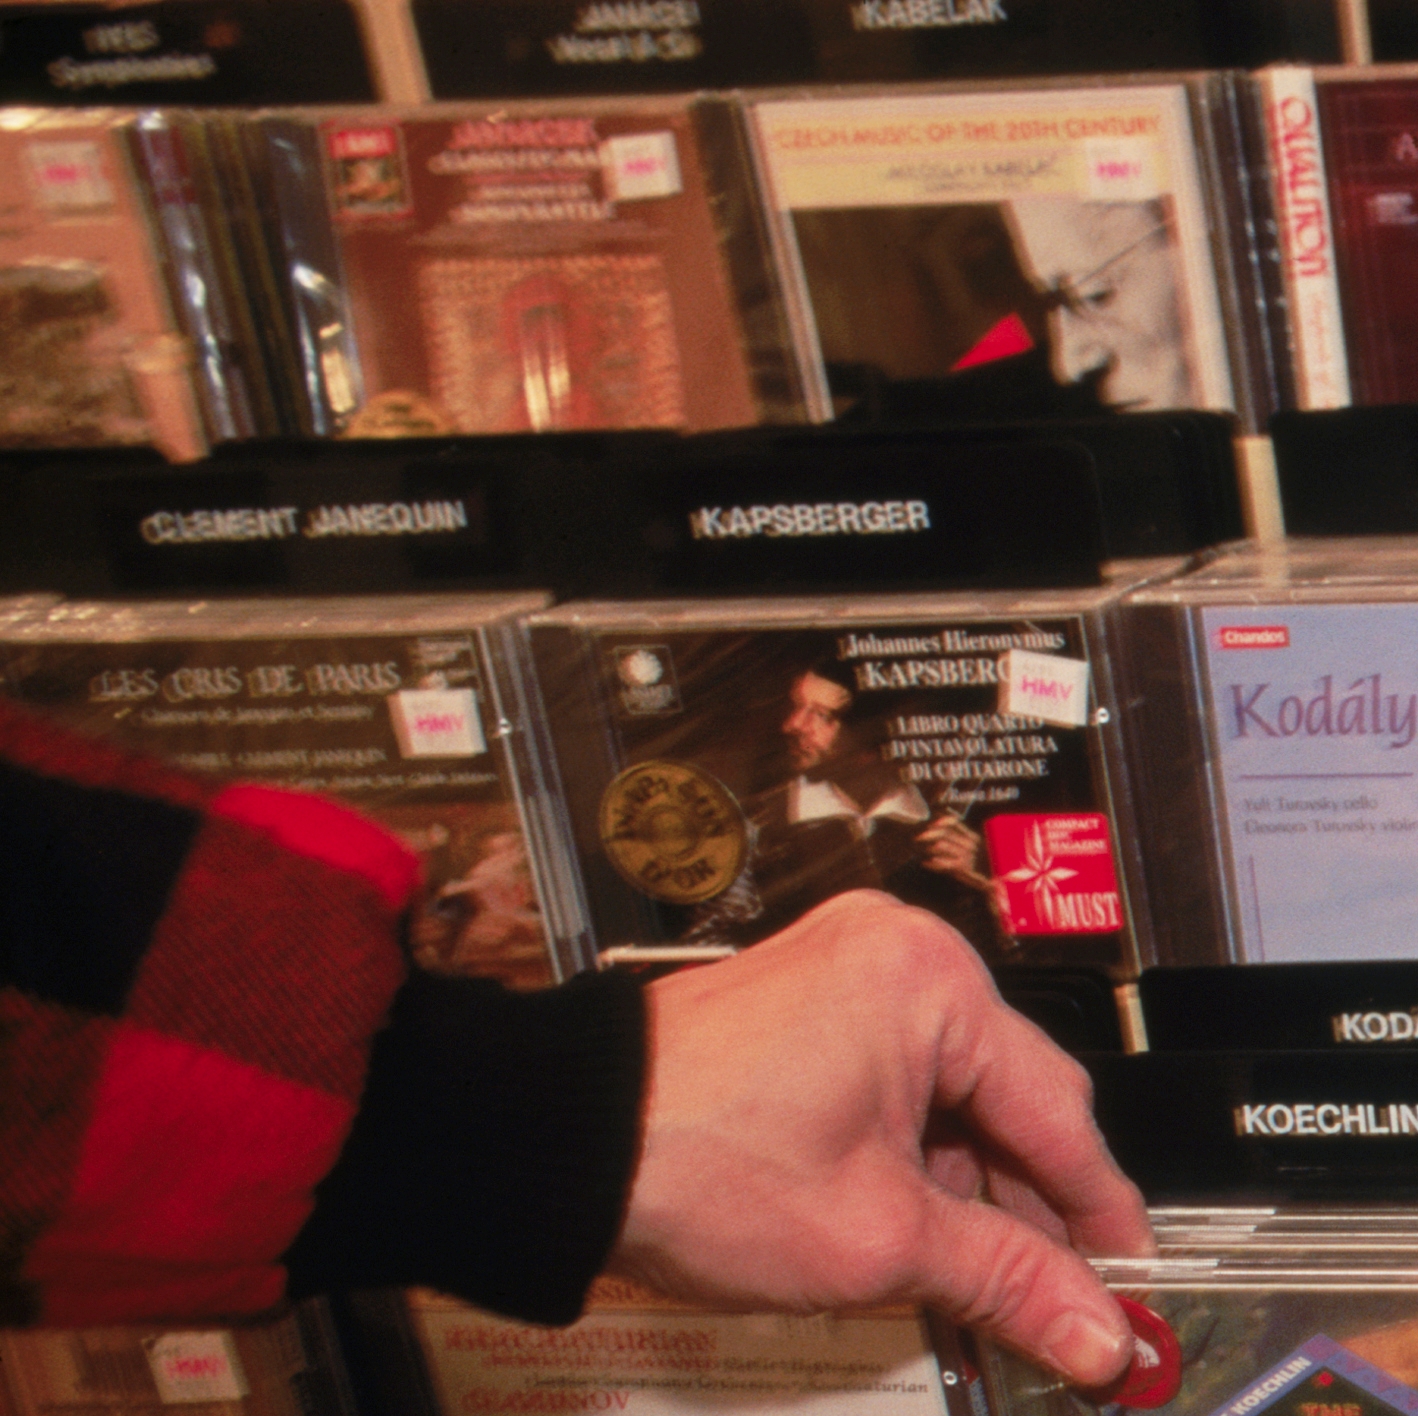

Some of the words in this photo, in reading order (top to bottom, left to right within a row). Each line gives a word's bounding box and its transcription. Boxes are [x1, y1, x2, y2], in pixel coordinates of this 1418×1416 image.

[147, 508, 298, 543] CLEMENT
[310, 502, 468, 537] JANEQUIN
[698, 502, 931, 535] KAPSBERGER
[846, 633, 940, 658] Johannes
[944, 628, 1065, 654] Hieronymus
[1224, 630, 1286, 645] Chandos
[1020, 677, 1073, 698] HMV
[1230, 668, 1418, 750] Kodály
[1058, 893, 1119, 927] MUST
